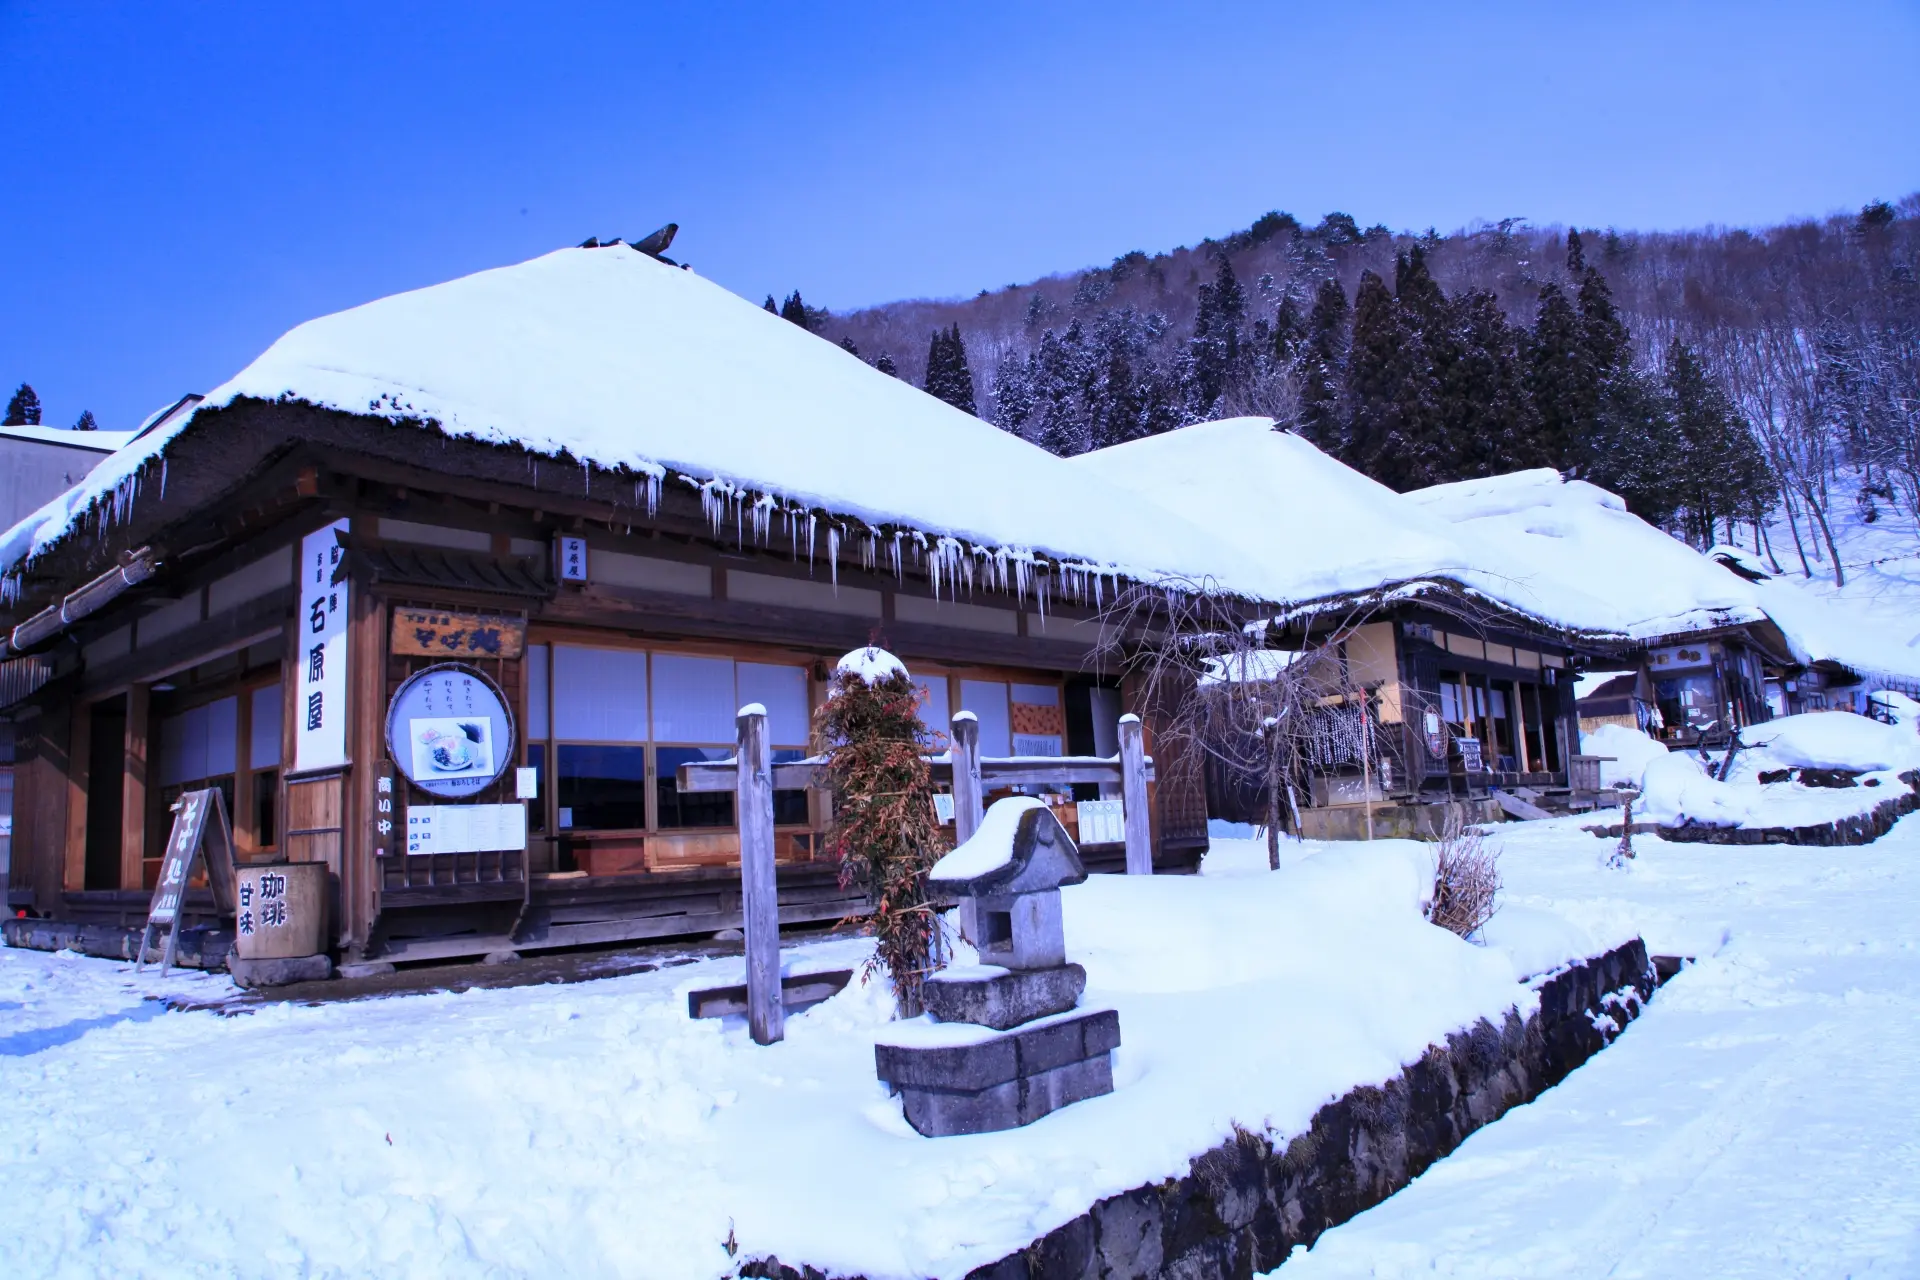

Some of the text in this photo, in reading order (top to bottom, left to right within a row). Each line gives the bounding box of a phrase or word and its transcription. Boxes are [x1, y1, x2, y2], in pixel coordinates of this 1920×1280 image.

[568, 541, 579, 576] 石原屋
[307, 596, 326, 732] 石原屋
[378, 776, 392, 836] 商い中
[239, 882, 255, 936] 甘味
[260, 872, 287, 928] 珈琲
